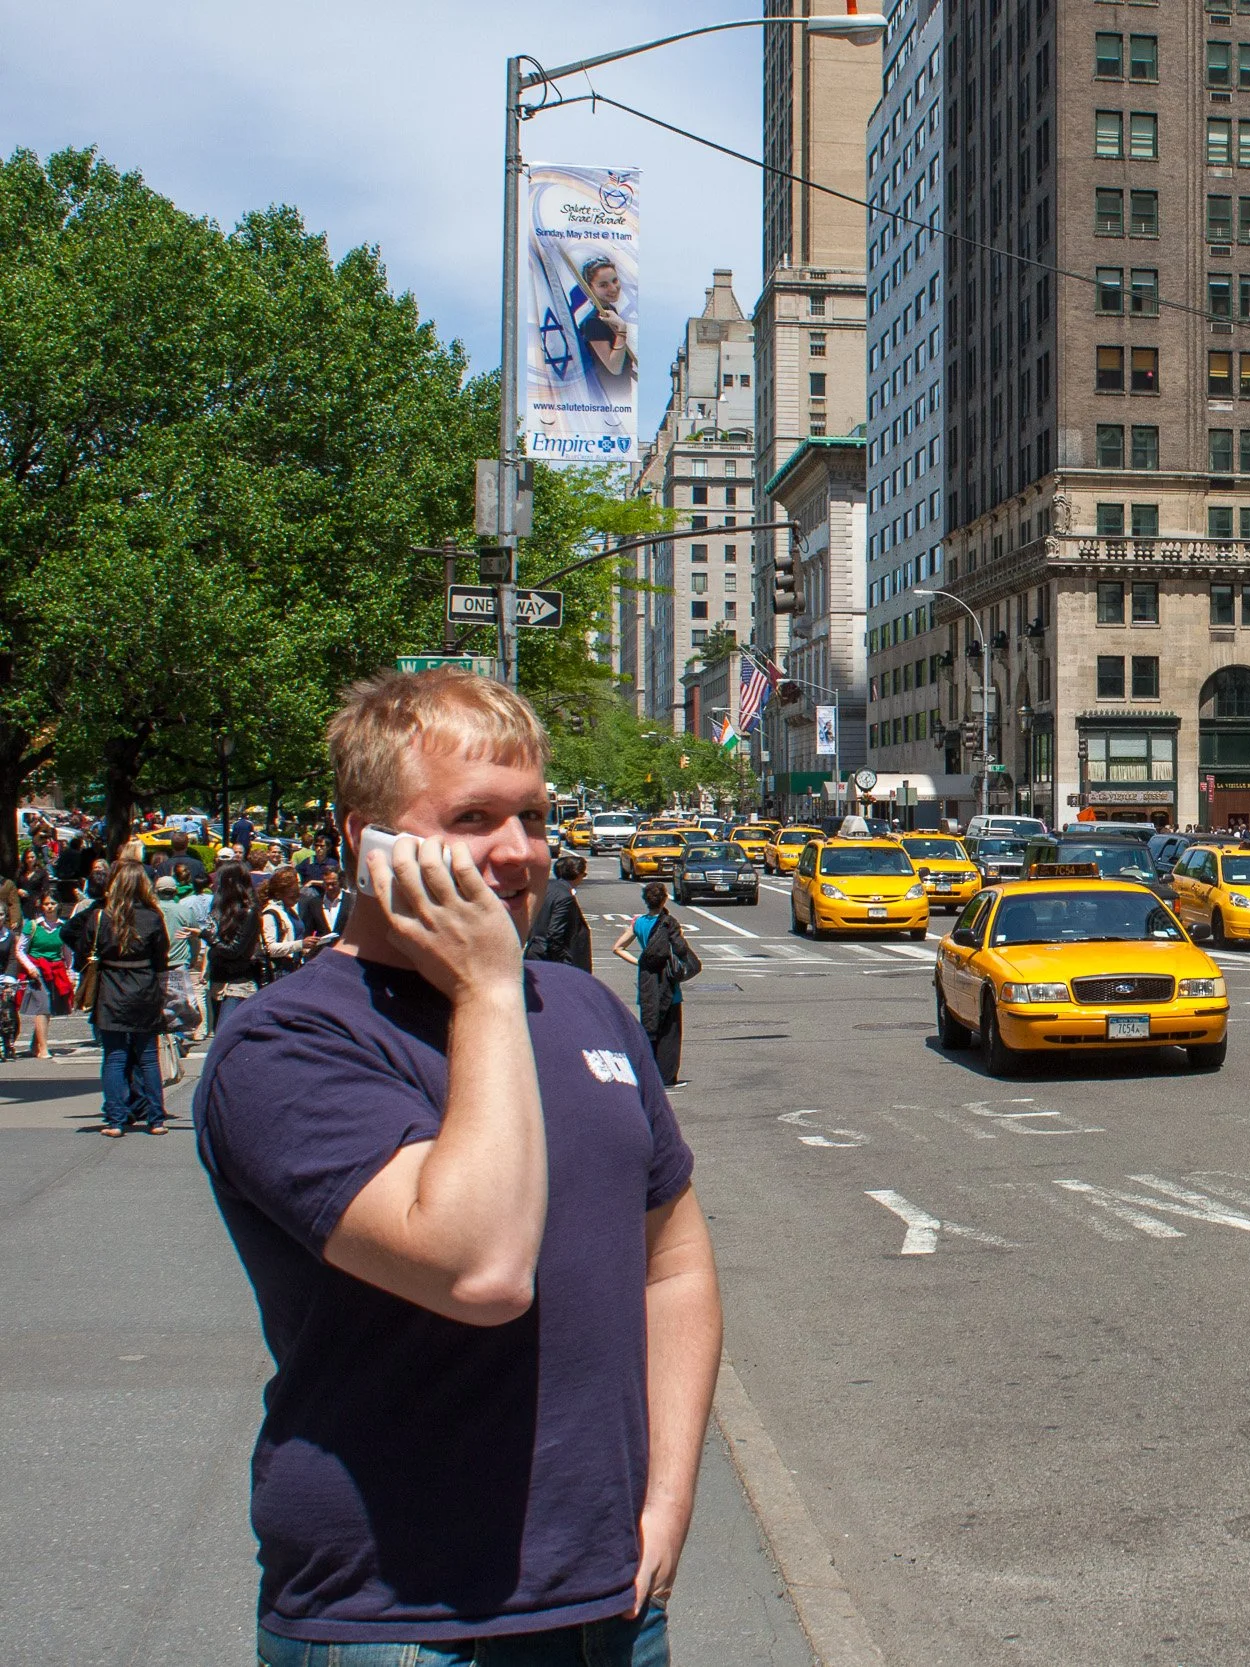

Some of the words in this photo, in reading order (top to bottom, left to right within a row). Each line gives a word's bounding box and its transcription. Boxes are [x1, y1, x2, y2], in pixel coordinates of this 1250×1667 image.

[560, 204, 592, 215] Salute
[568, 212, 593, 223] Israel
[593, 212, 627, 225] Parade
[535, 227, 566, 239] Sunday,
[566, 230, 582, 240] May
[583, 230, 600, 240] 31st
[601, 231, 610, 239] @
[611, 232, 632, 241] 11am
[533, 402, 632, 413] www.salutetoisrael.com
[532, 432, 596, 457] Empire
[464, 597, 495, 613] ONE
[516, 602, 546, 616] WAY
[401, 661, 417, 674] W
[1055, 866, 1075, 876] 7C54
